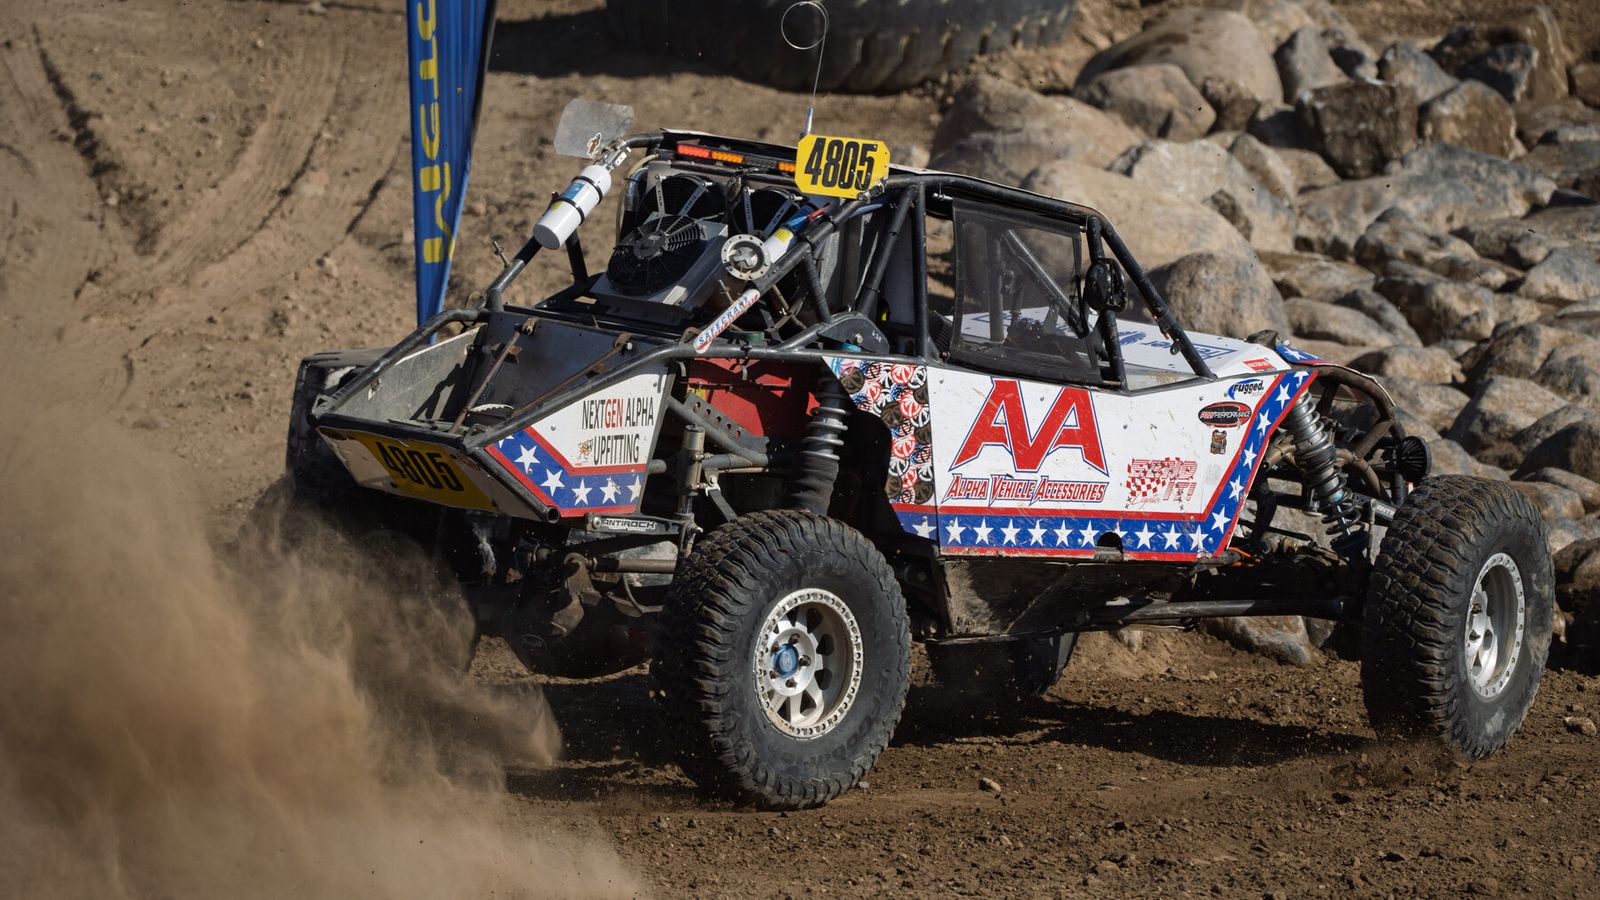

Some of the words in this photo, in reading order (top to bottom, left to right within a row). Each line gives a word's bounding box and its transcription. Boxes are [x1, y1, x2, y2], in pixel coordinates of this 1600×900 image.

[804, 137, 878, 191] 4805
[582, 398, 624, 429] NEXTGEN
[625, 397, 654, 427] ALPHA
[949, 376, 1109, 477] AVA
[593, 434, 640, 465] UPFITTING
[376, 441, 464, 491] 4805
[944, 474, 989, 502] ALPHA
[990, 475, 1034, 503] VEHICLE
[1032, 476, 1108, 503] ACCESSORIES
[601, 518, 656, 529] ANTIROCK
